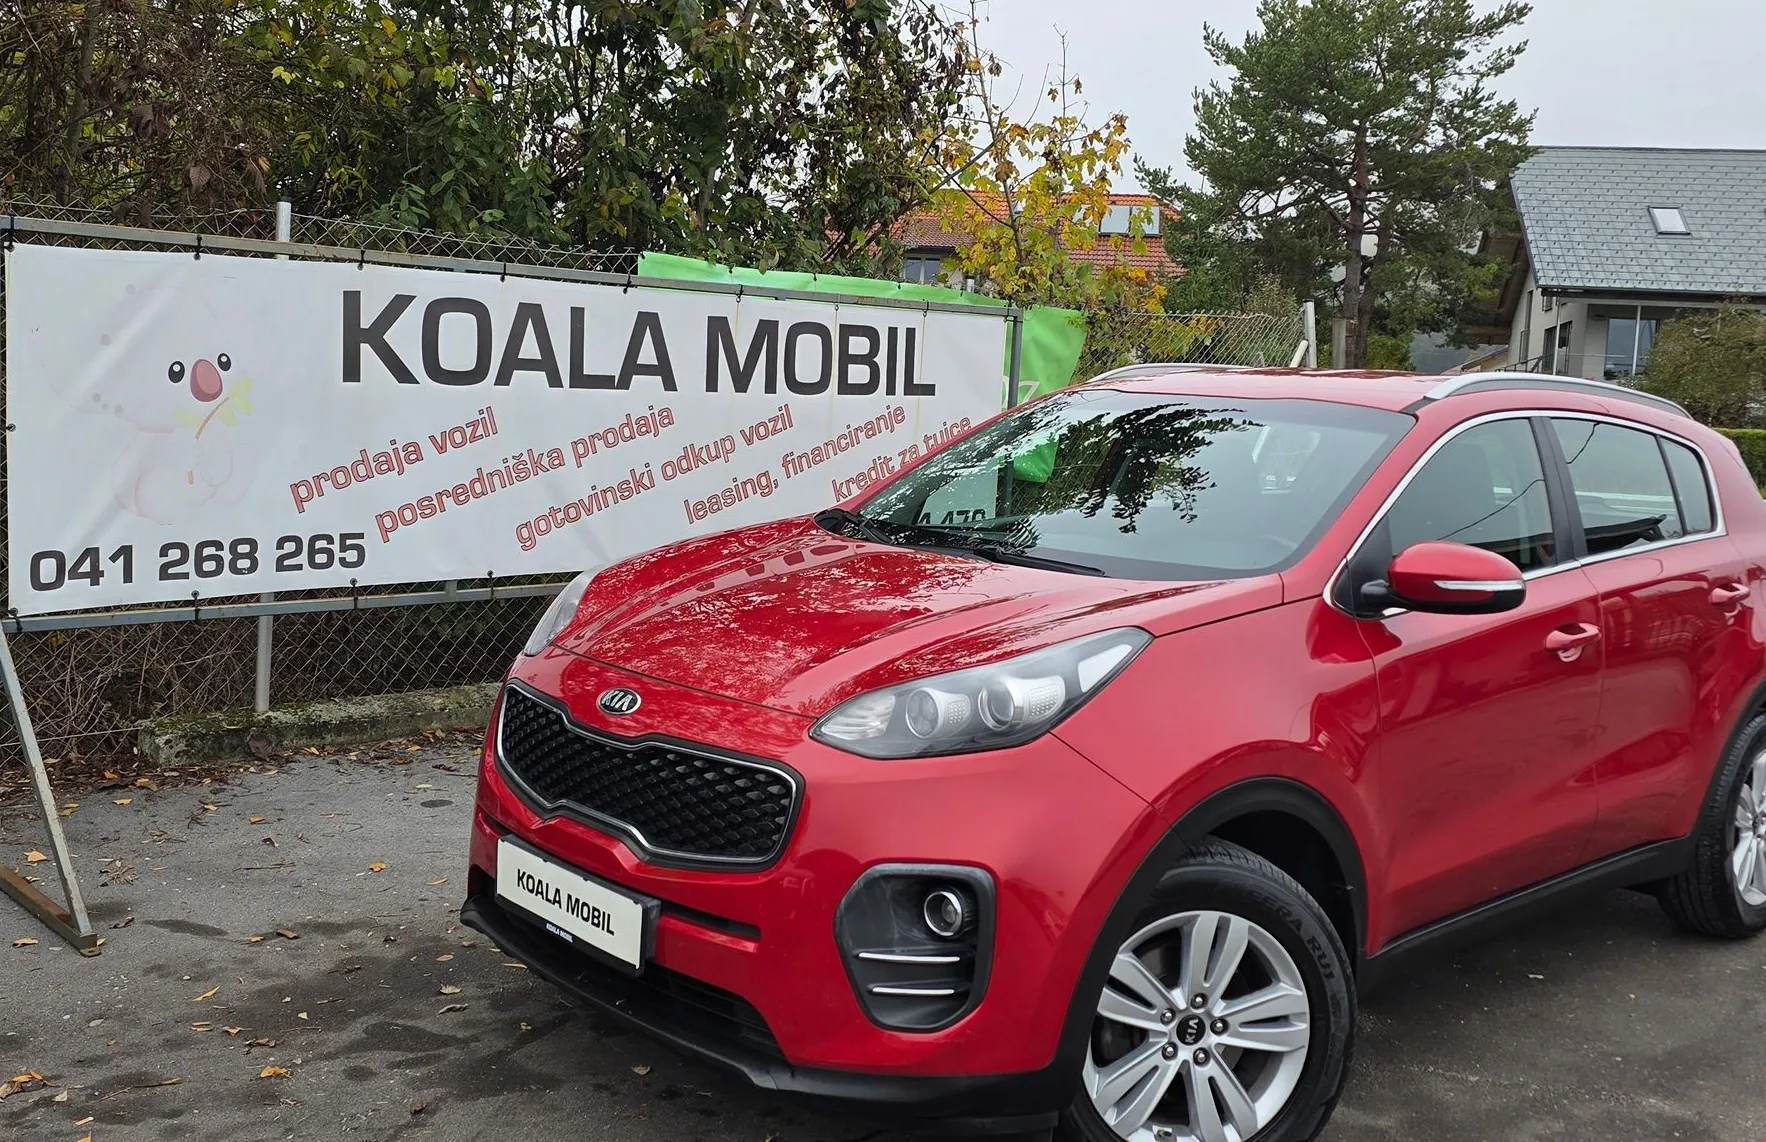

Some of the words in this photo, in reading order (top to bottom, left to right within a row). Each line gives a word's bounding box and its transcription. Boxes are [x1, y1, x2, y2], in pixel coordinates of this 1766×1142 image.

[342, 289, 678, 392] KOALA
[705, 315, 936, 396] MOBIL
[290, 439, 424, 514] prodaja
[428, 405, 498, 455] vozil
[374, 447, 566, 543] posredniška
[570, 404, 675, 468] prodaja
[515, 463, 655, 552] gotovinski
[661, 431, 736, 481] odkup
[740, 404, 794, 446] vozil
[684, 467, 780, 524] leasing,
[781, 404, 906, 479] financiranje
[831, 455, 895, 502] kredit
[897, 443, 921, 468] za
[30, 544, 134, 592] 041
[158, 537, 259, 582] 268
[275, 532, 367, 573] 265
[601, 690, 633, 711] KIA
[517, 868, 562, 910] KOALA
[566, 893, 615, 936] MOBIL
